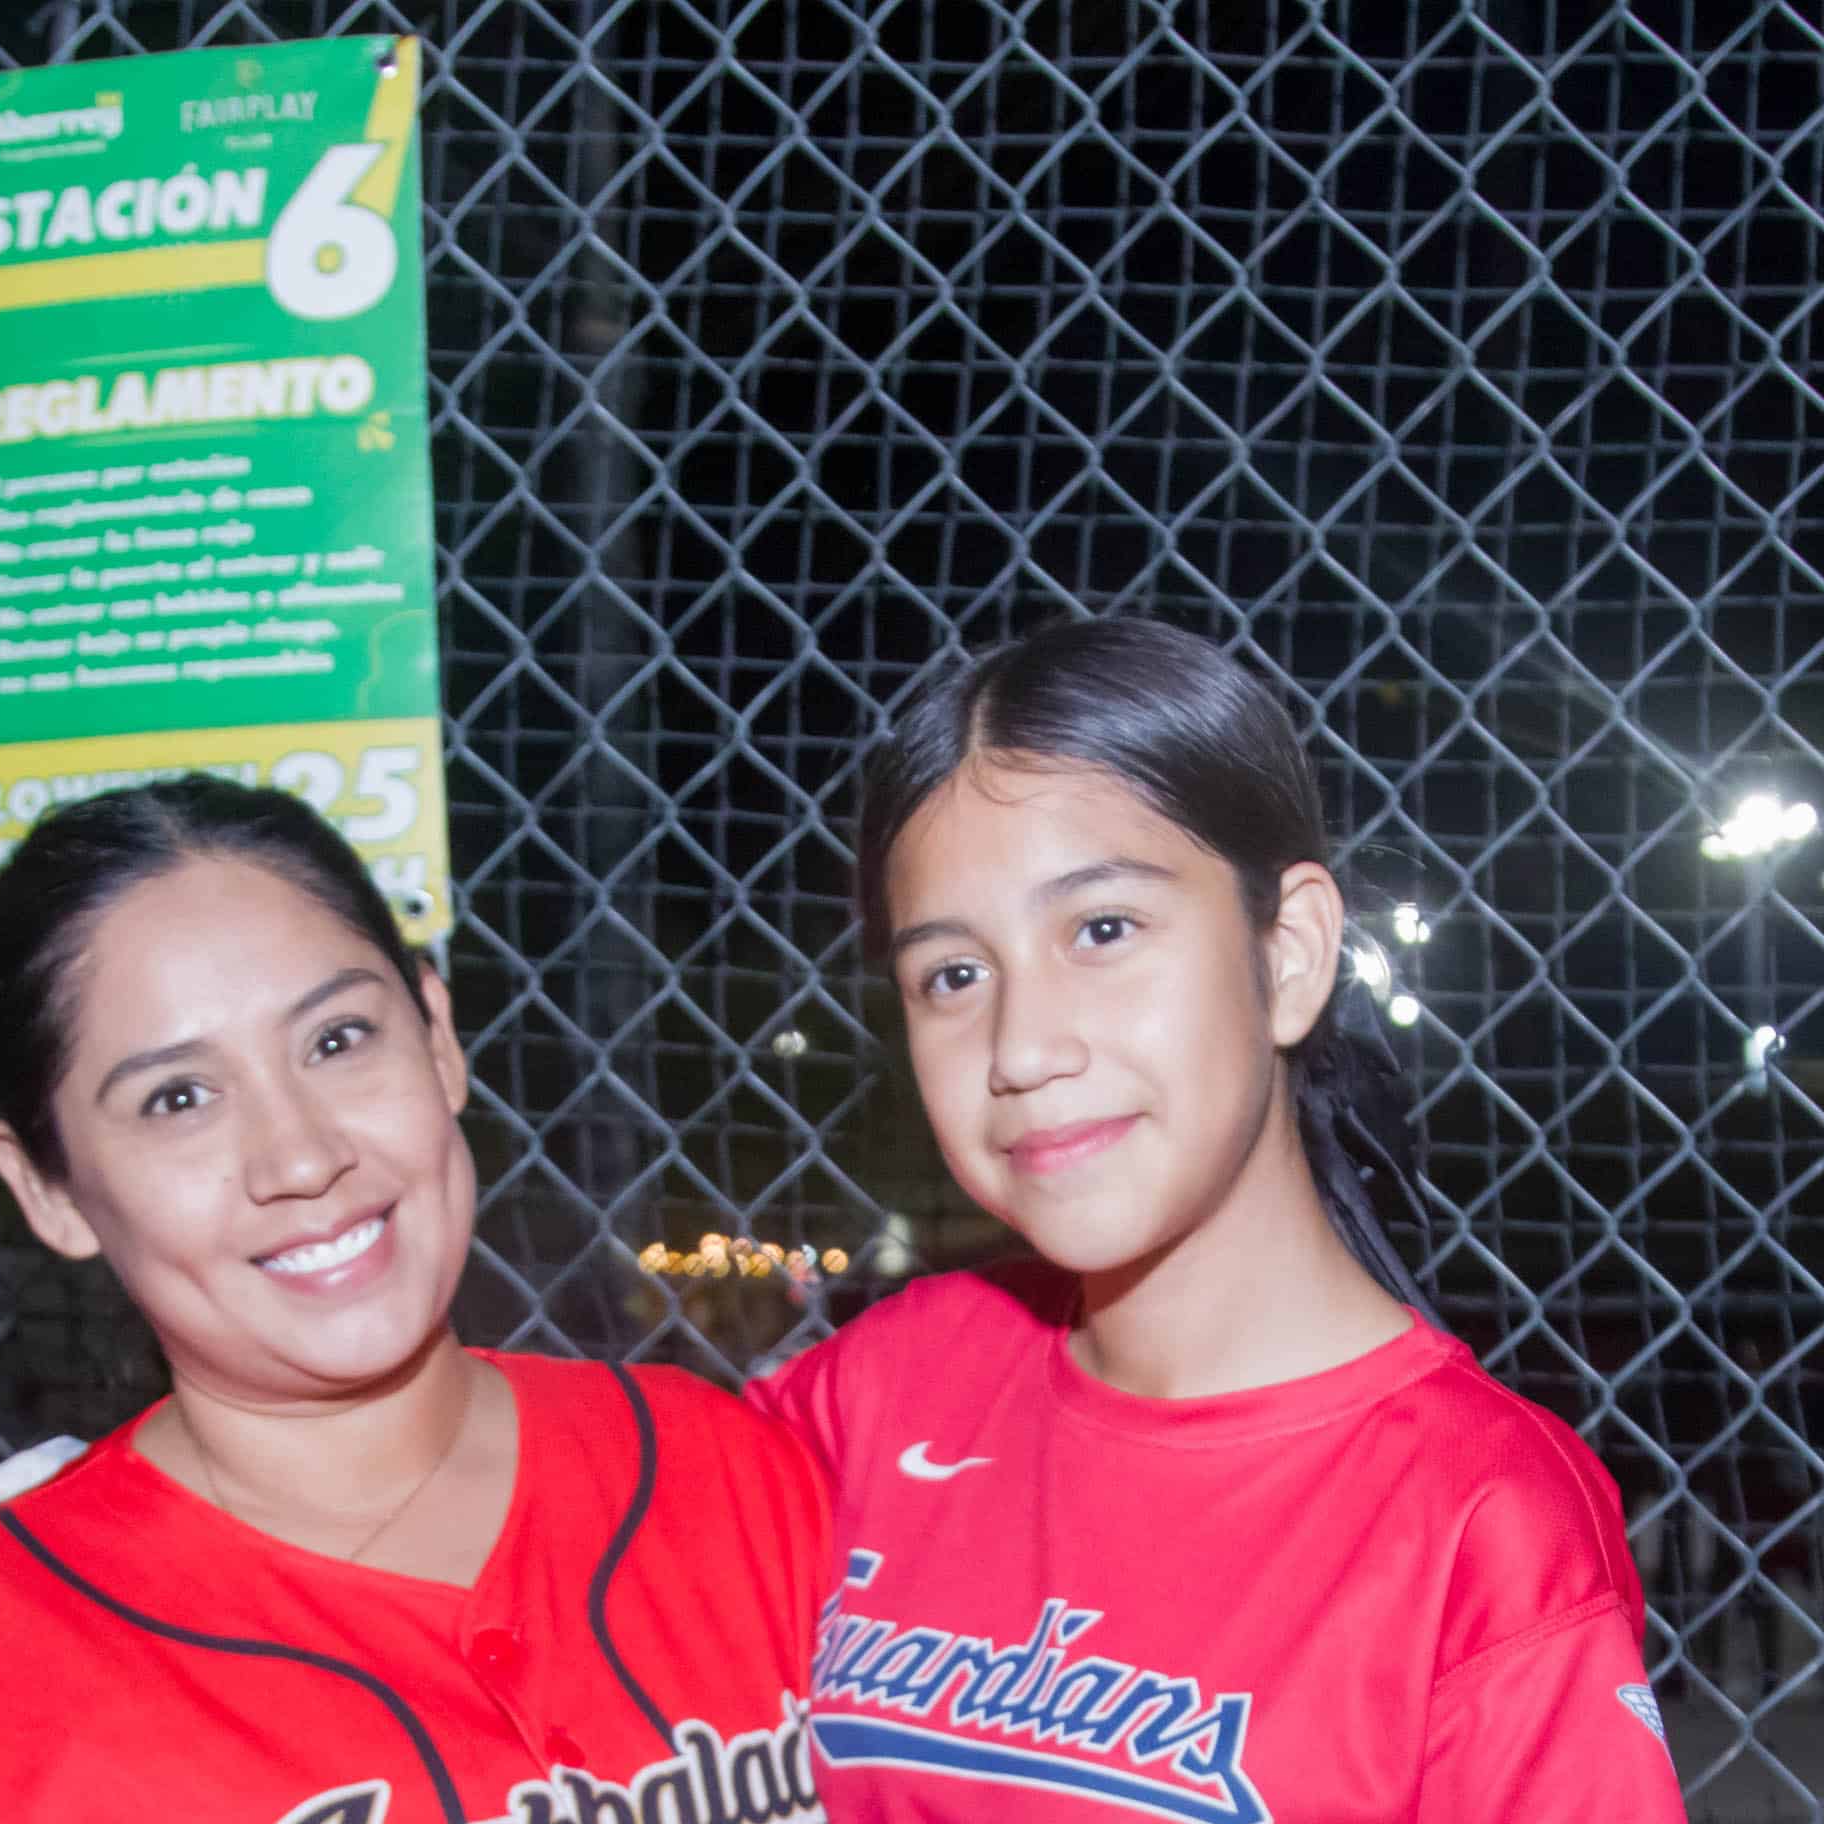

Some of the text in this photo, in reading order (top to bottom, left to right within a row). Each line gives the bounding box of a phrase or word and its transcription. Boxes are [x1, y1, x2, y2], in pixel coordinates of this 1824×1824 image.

[179, 89, 319, 133] FAIRPLAY
[266, 142, 398, 321] 6
[273, 748, 419, 841] 25
[810, 1546, 1256, 1784] uardians
